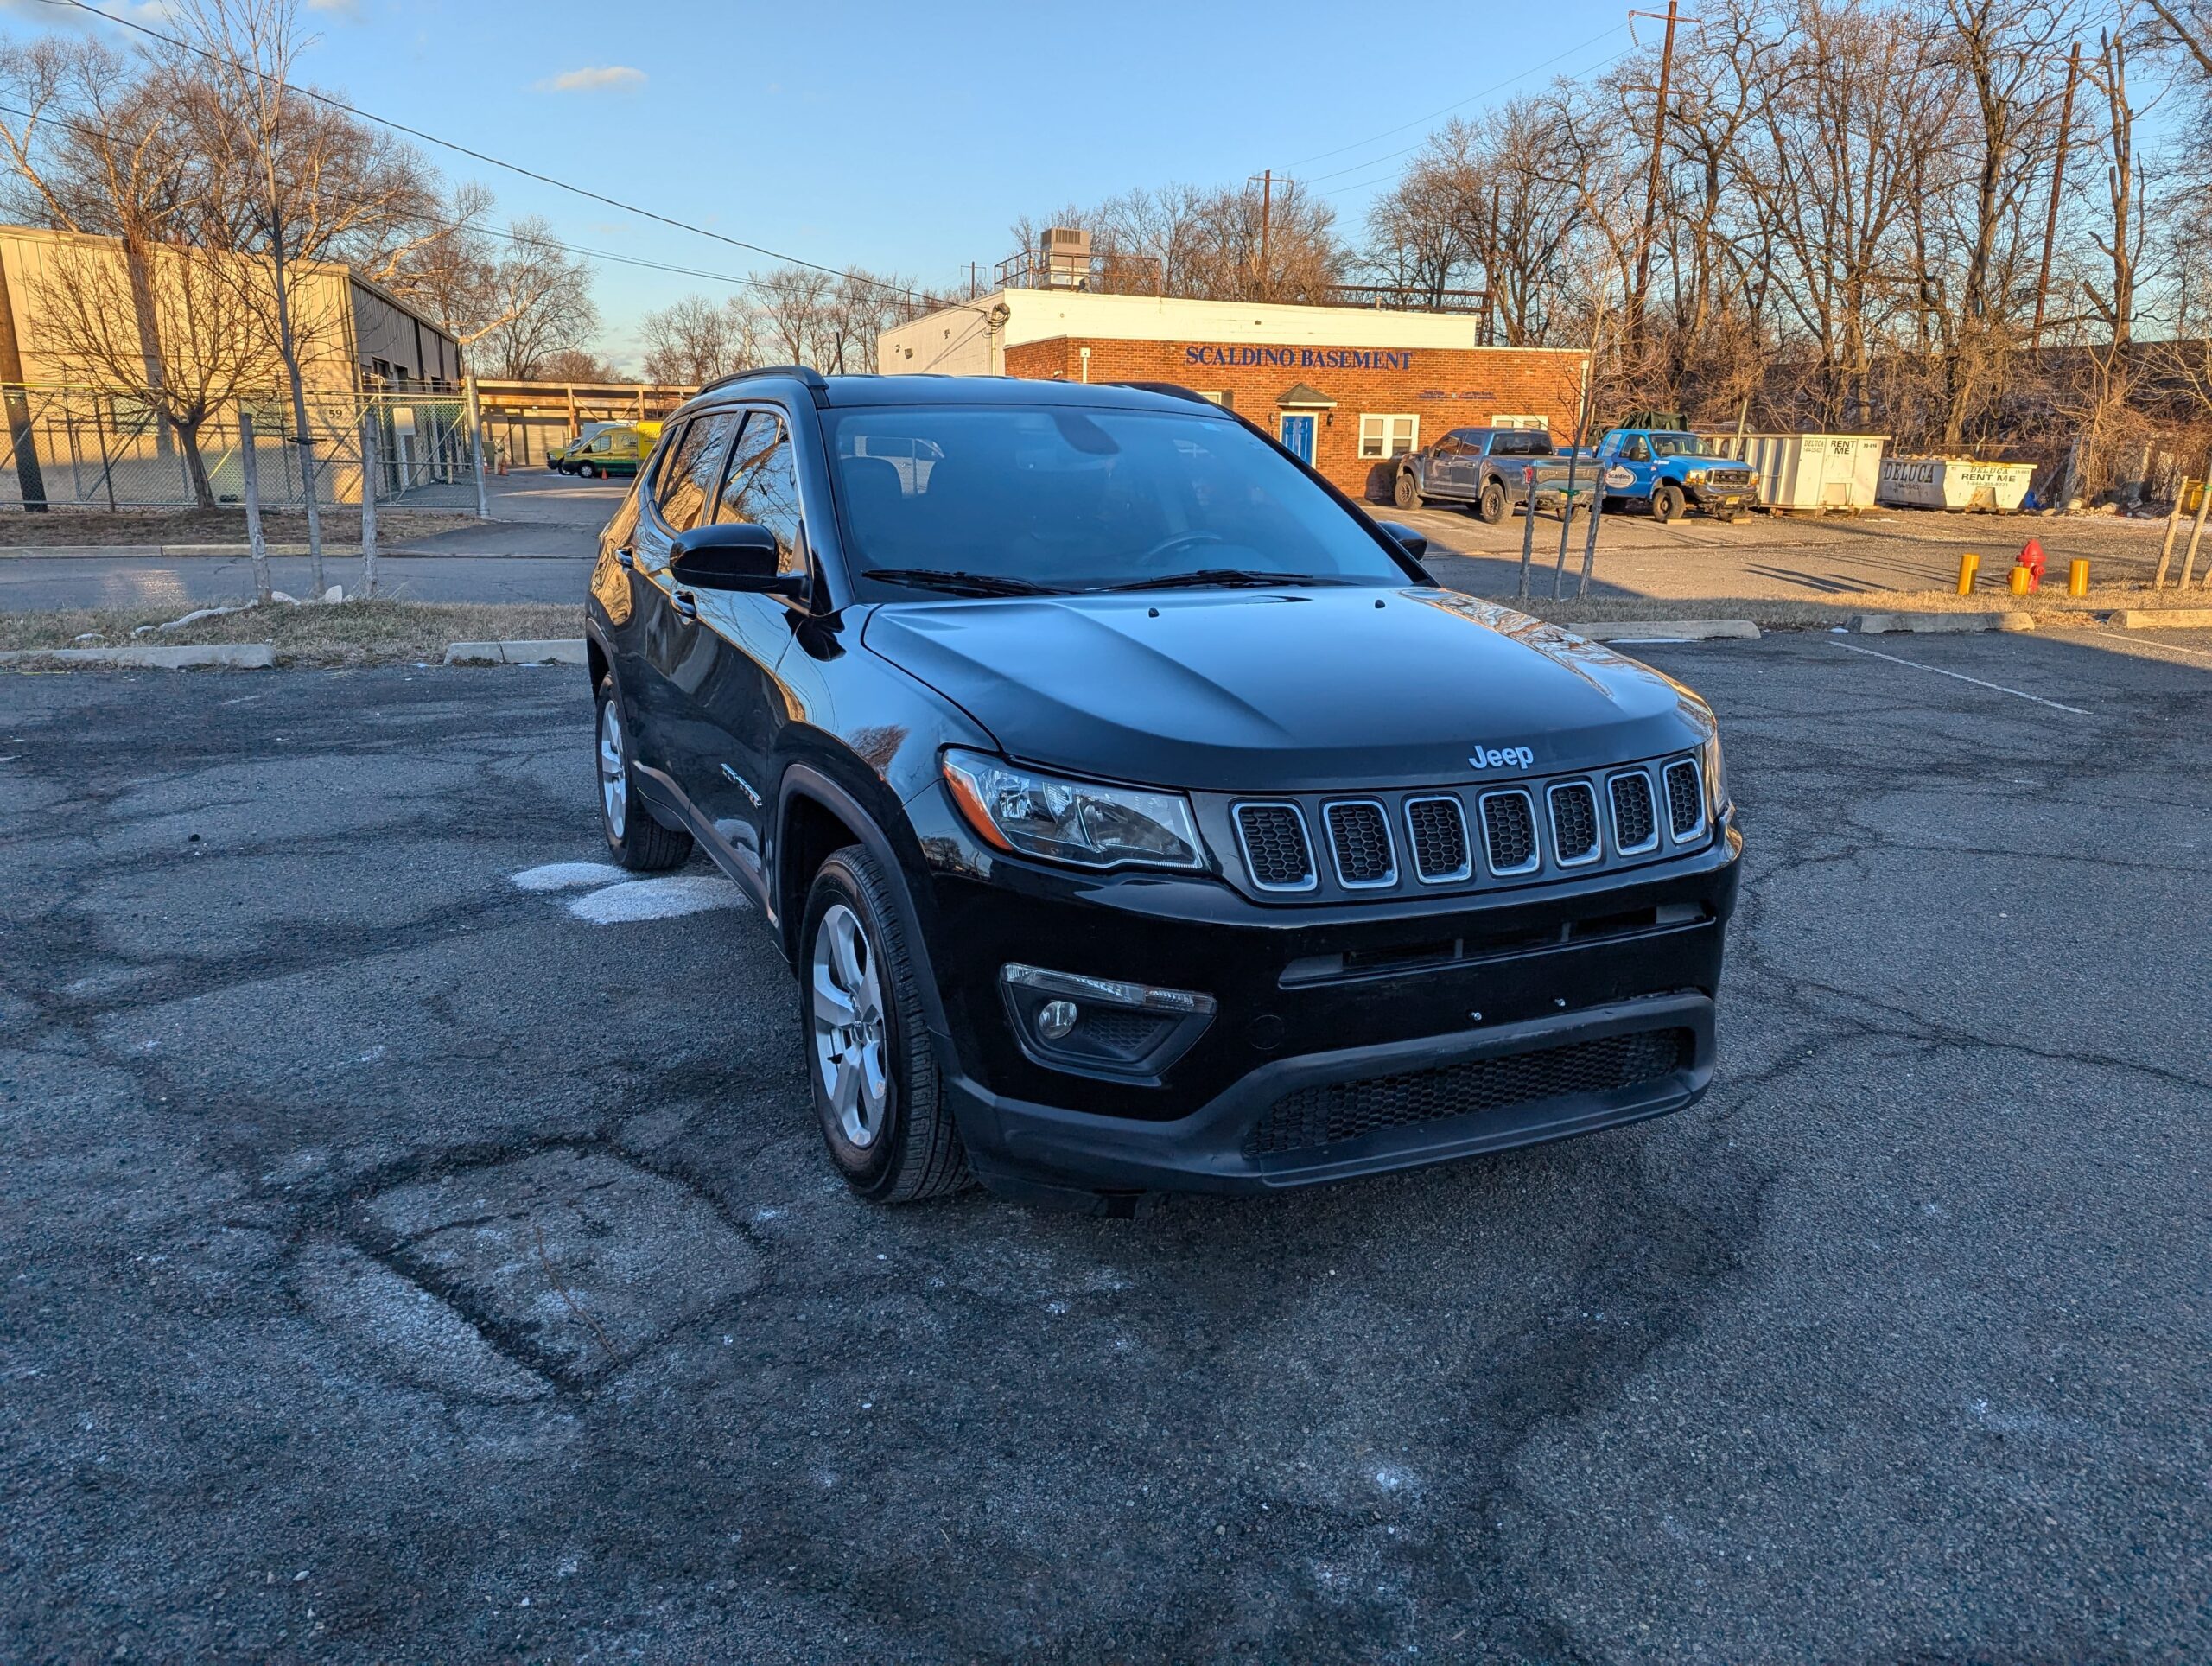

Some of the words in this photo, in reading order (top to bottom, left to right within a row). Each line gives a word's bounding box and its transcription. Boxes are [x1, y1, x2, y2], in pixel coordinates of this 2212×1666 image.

[1186, 347, 1295, 367] SCALDINO
[1301, 349, 1413, 370] BASEMENT
[329, 409, 342, 418] 59
[1804, 439, 1824, 448] DELUCA
[1883, 462, 1935, 483] DELUCA
[1468, 745, 1534, 770] Jeep
